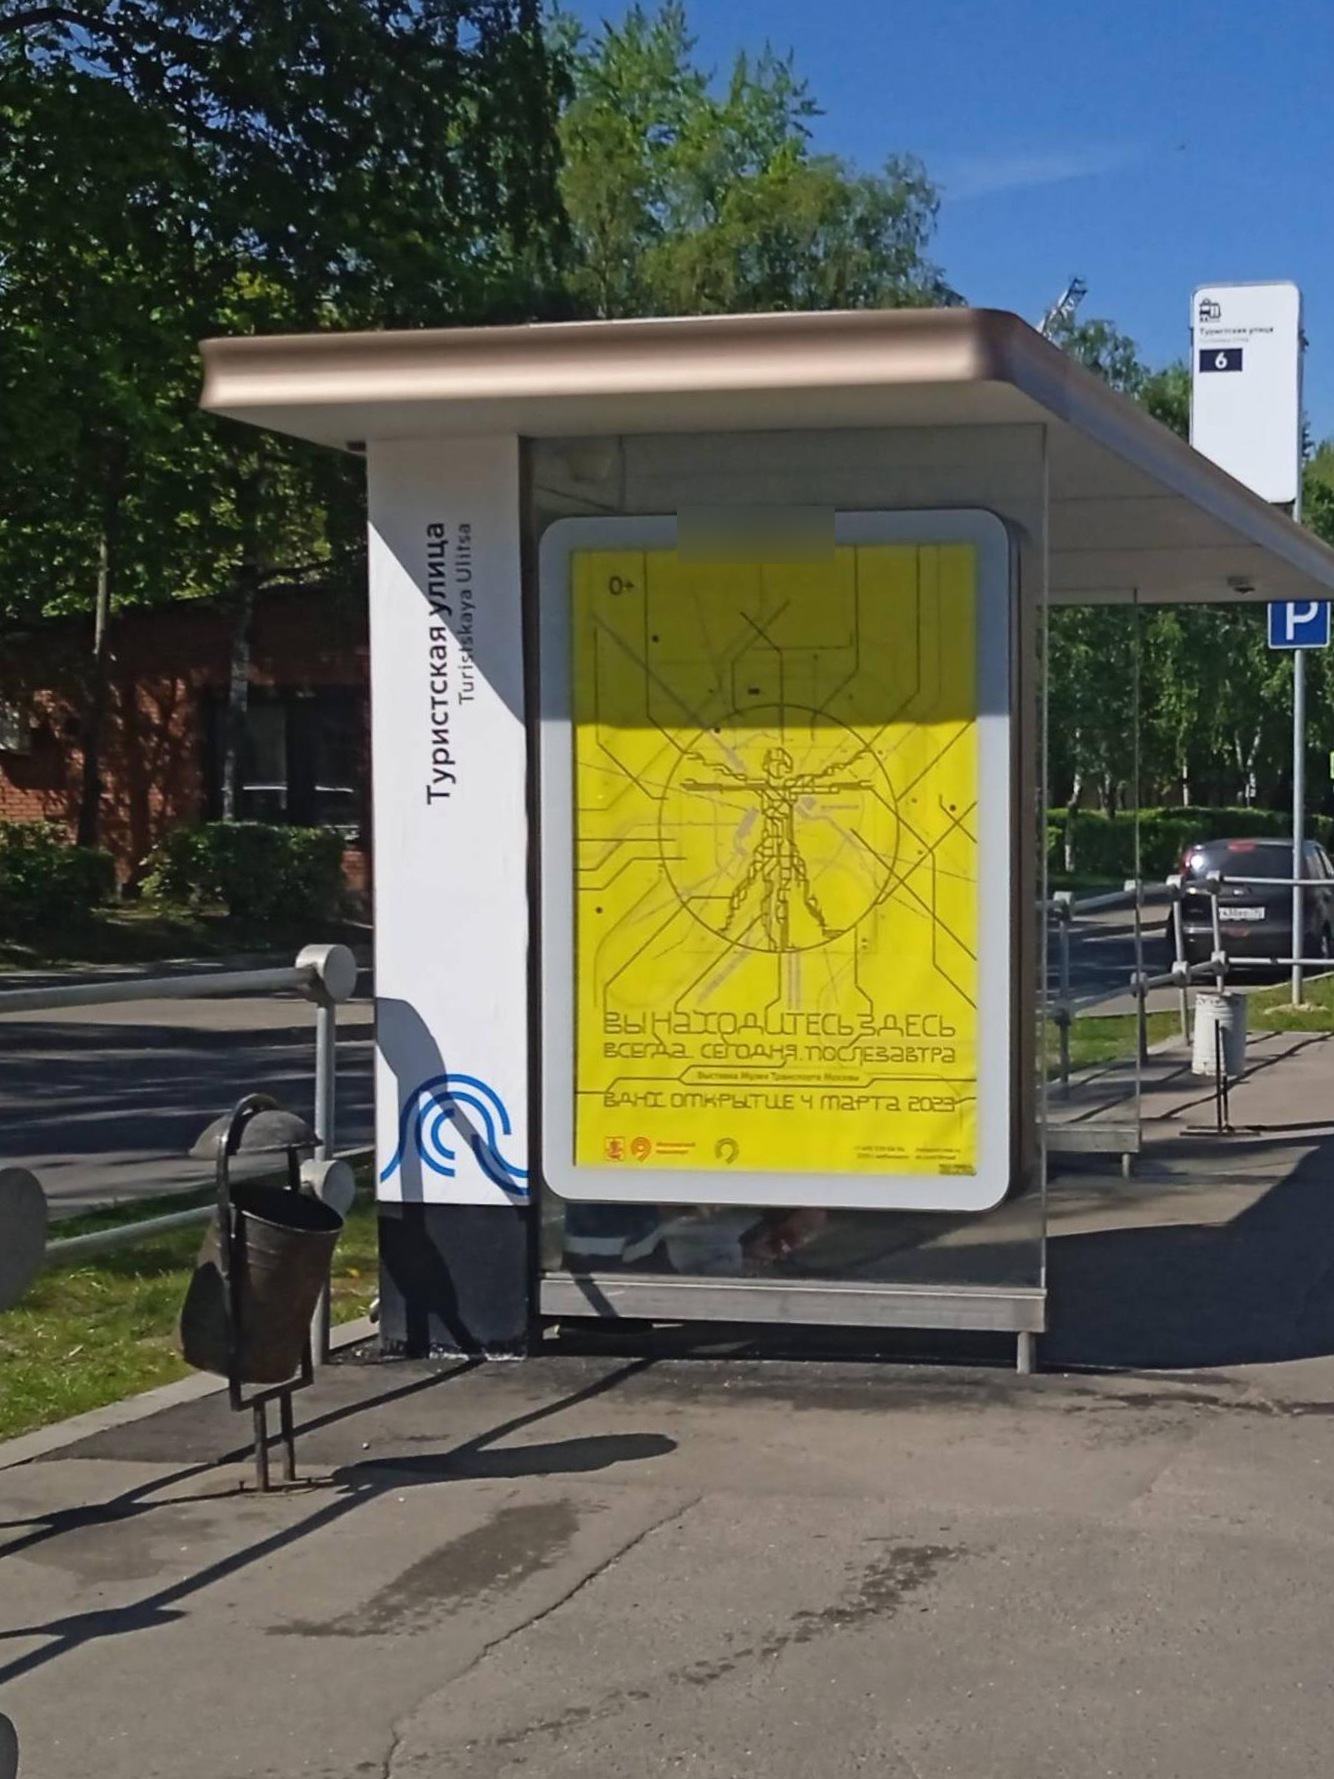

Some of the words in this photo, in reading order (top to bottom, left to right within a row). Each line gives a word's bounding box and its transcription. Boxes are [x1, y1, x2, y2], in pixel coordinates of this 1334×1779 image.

[1215, 352, 1228, 369] 6
[426, 522, 452, 617] улица
[455, 522, 472, 582] Ulitsa
[609, 576, 635, 595] 0+
[1286, 601, 1318, 640] P
[456, 589, 476, 705] Turistskaya
[427, 626, 456, 805] Туристская
[801, 1094, 814, 1110] 4
[908, 1095, 956, 1113] 2023
